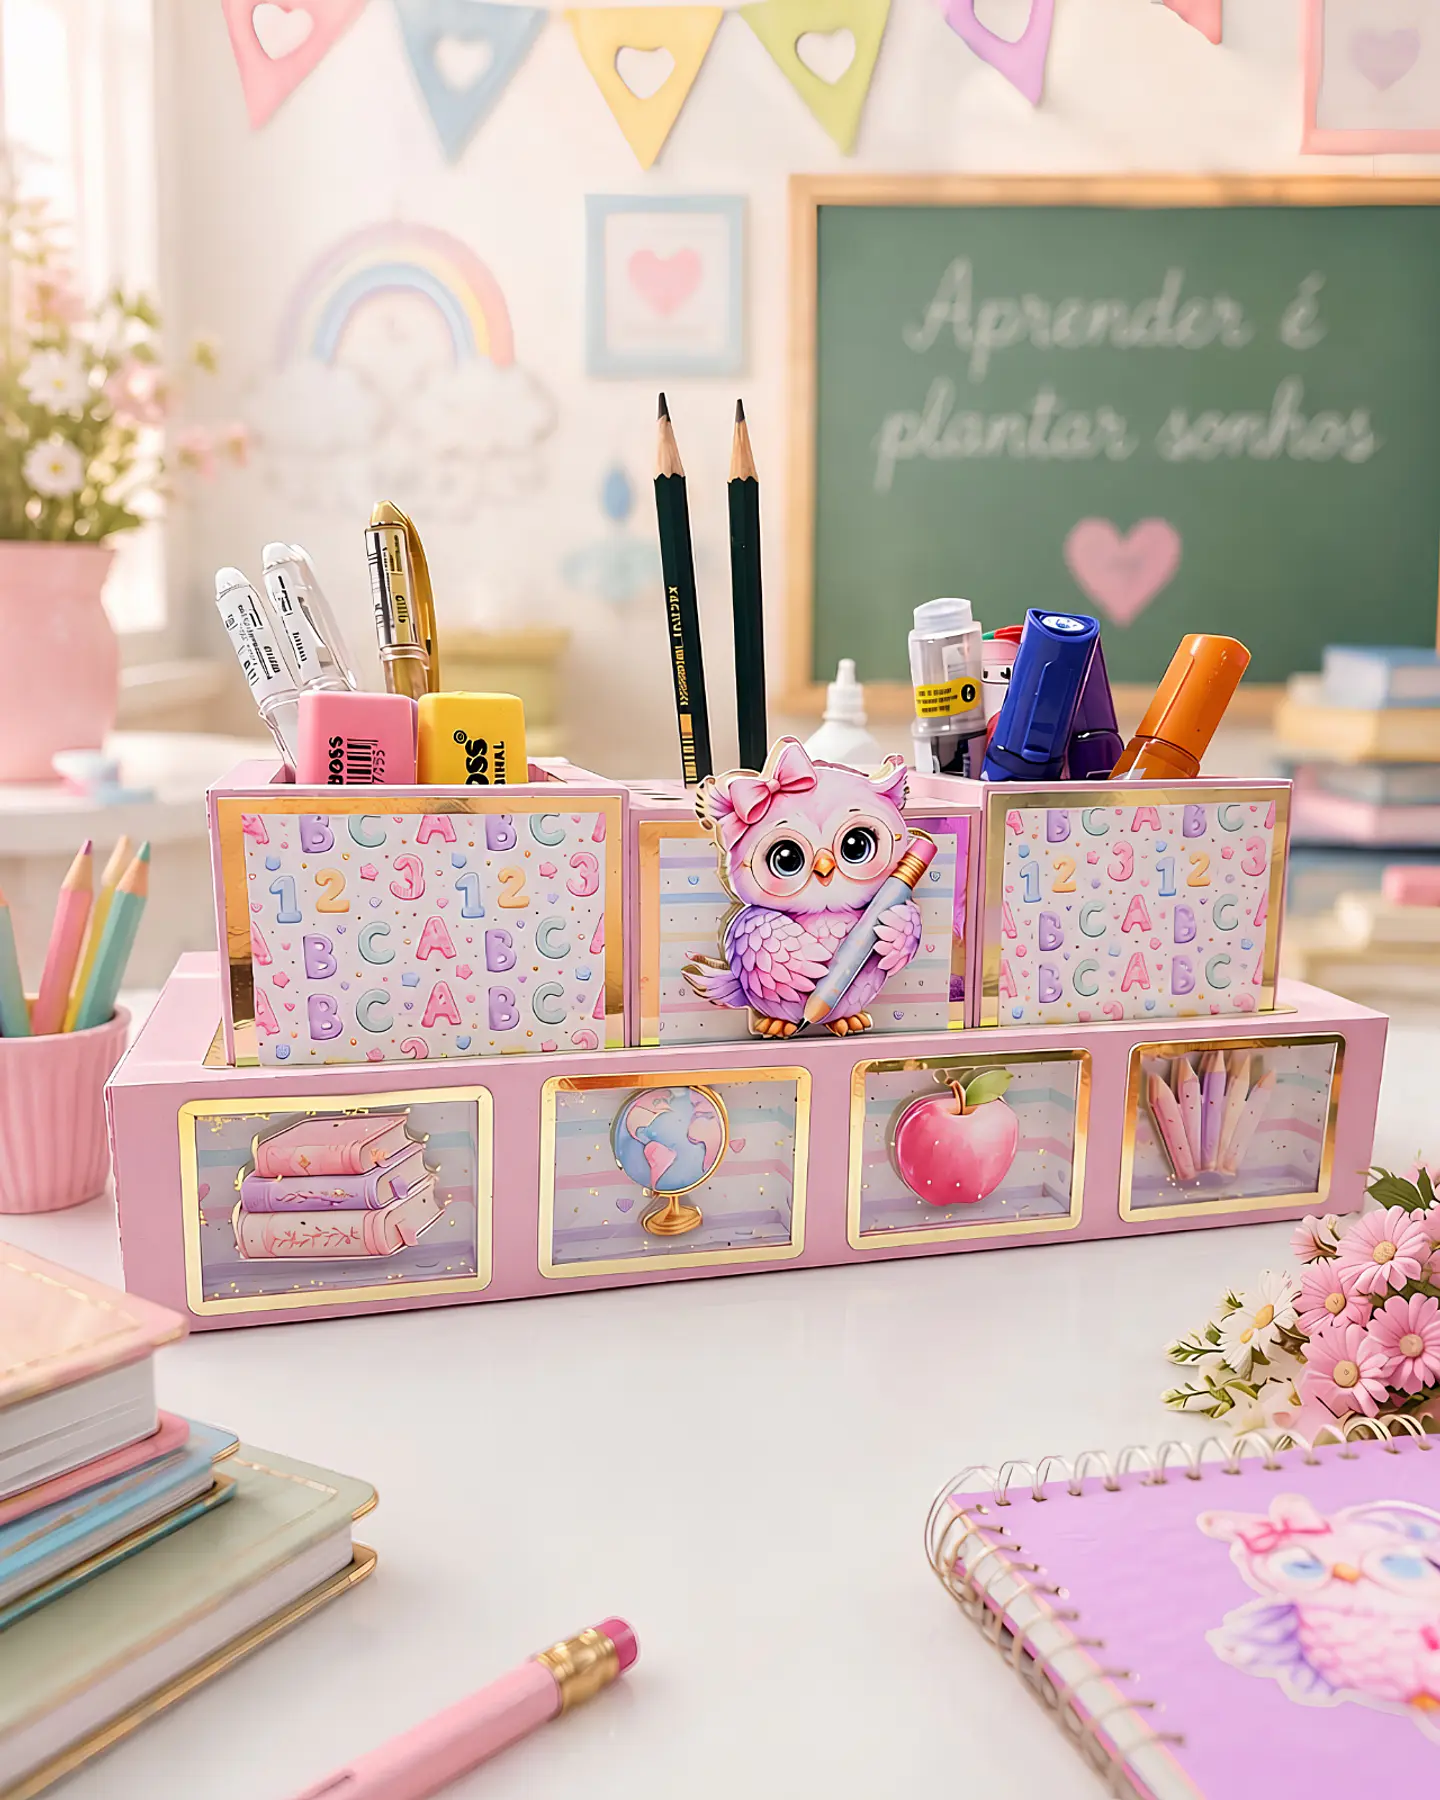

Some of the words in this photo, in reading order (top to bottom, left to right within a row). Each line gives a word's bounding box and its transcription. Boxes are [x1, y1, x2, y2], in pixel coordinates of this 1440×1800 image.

[903, 256, 1252, 380] Aprender
[1279, 270, 1329, 351] é
[872, 378, 1138, 492] plantar
[1157, 375, 1376, 463] sonhos
[300, 814, 334, 853] B
[348, 814, 387, 847] C
[416, 815, 457, 844] A
[486, 814, 517, 851] B
[529, 813, 566, 845] C
[1047, 809, 1071, 843] B
[1081, 808, 1110, 836] C
[1131, 807, 1161, 832] A
[1182, 806, 1207, 838] B
[1217, 805, 1245, 832] C
[269, 876, 302, 924] 1
[314, 868, 350, 913] 2
[389, 853, 426, 900] 3
[455, 872, 485, 918] 1
[497, 866, 530, 908] 2
[566, 852, 599, 897] 3
[1020, 861, 1042, 903] 1
[1052, 856, 1076, 892] 2
[1107, 841, 1134, 882] 3
[1156, 857, 1176, 896] 1
[1187, 852, 1210, 886] 2
[1241, 836, 1267, 876] 3
[303, 933, 337, 979] B
[358, 921, 396, 964] C
[416, 915, 457, 960] A
[485, 929, 517, 972] B
[535, 916, 571, 959] C
[1038, 912, 1064, 952] B
[1079, 902, 1107, 937] C
[1121, 894, 1151, 933] A
[1174, 904, 1197, 944] B
[1212, 894, 1239, 931] C
[1039, 964, 1063, 1003] B
[1073, 959, 1100, 996] C
[1121, 952, 1151, 992] A
[1171, 955, 1195, 996] B
[1205, 953, 1231, 989] C
[308, 994, 343, 1040] B
[356, 989, 394, 1033] C
[421, 981, 462, 1028] A
[488, 986, 520, 1031] B
[532, 982, 567, 1024] C
